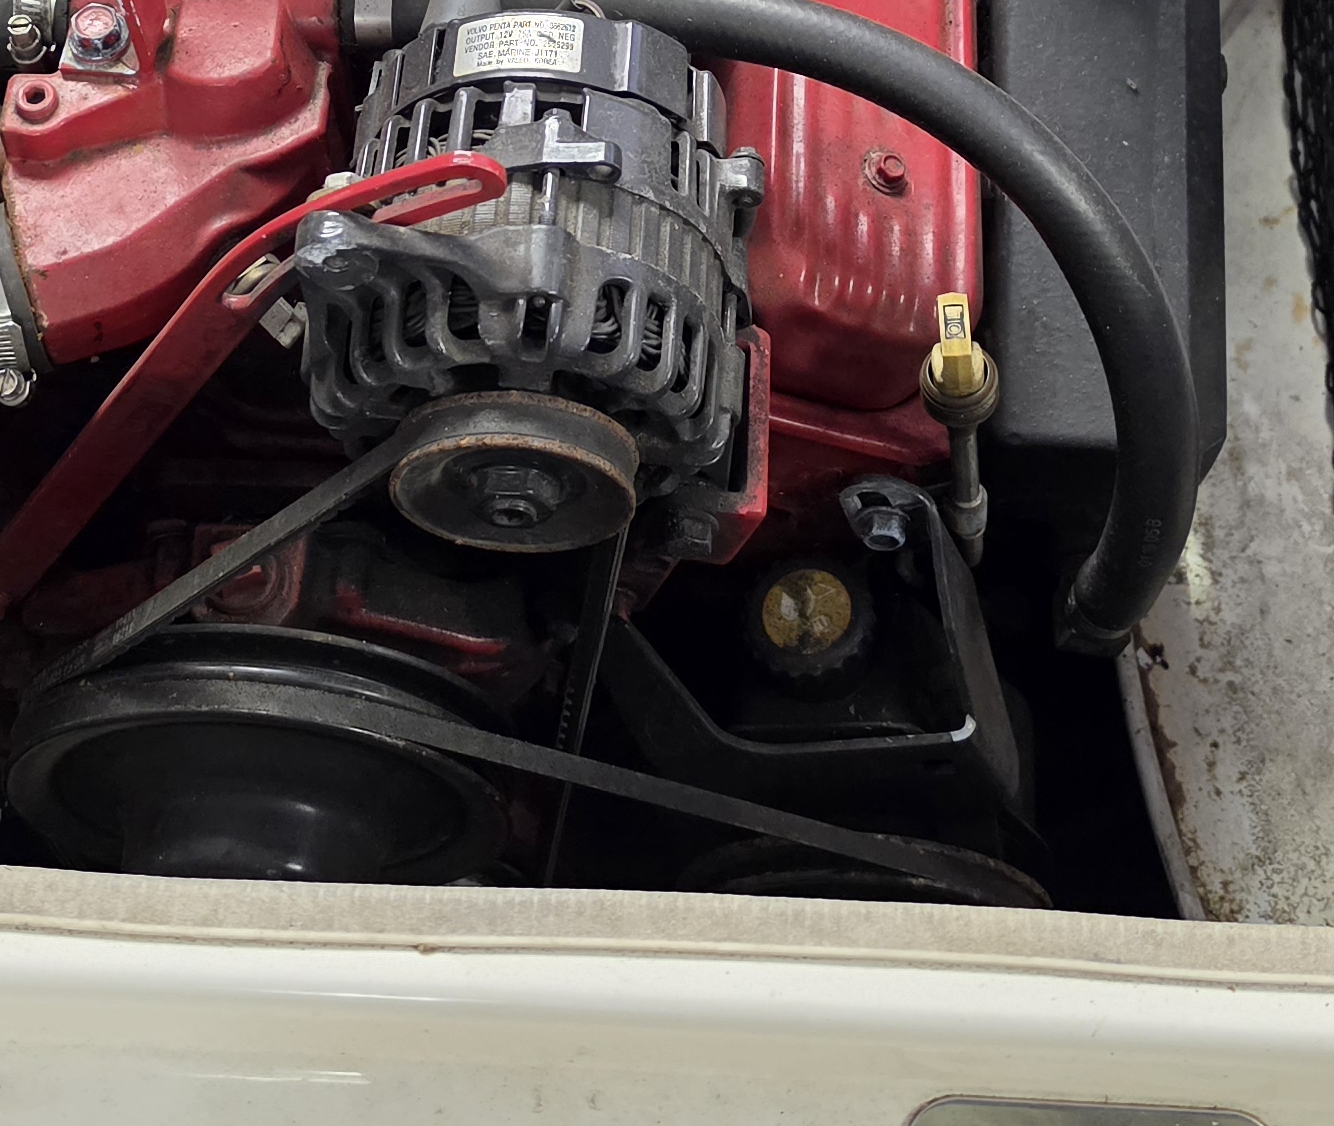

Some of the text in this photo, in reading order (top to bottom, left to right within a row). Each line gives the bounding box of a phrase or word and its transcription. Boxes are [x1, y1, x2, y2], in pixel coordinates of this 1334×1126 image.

[466, 24, 487, 35] VOLVO
[489, 22, 511, 32] PENTA
[513, 20, 531, 29] PART
[465, 32, 495, 44] OUTPUT
[558, 32, 576, 42] NEG
[498, 38, 518, 48] PART
